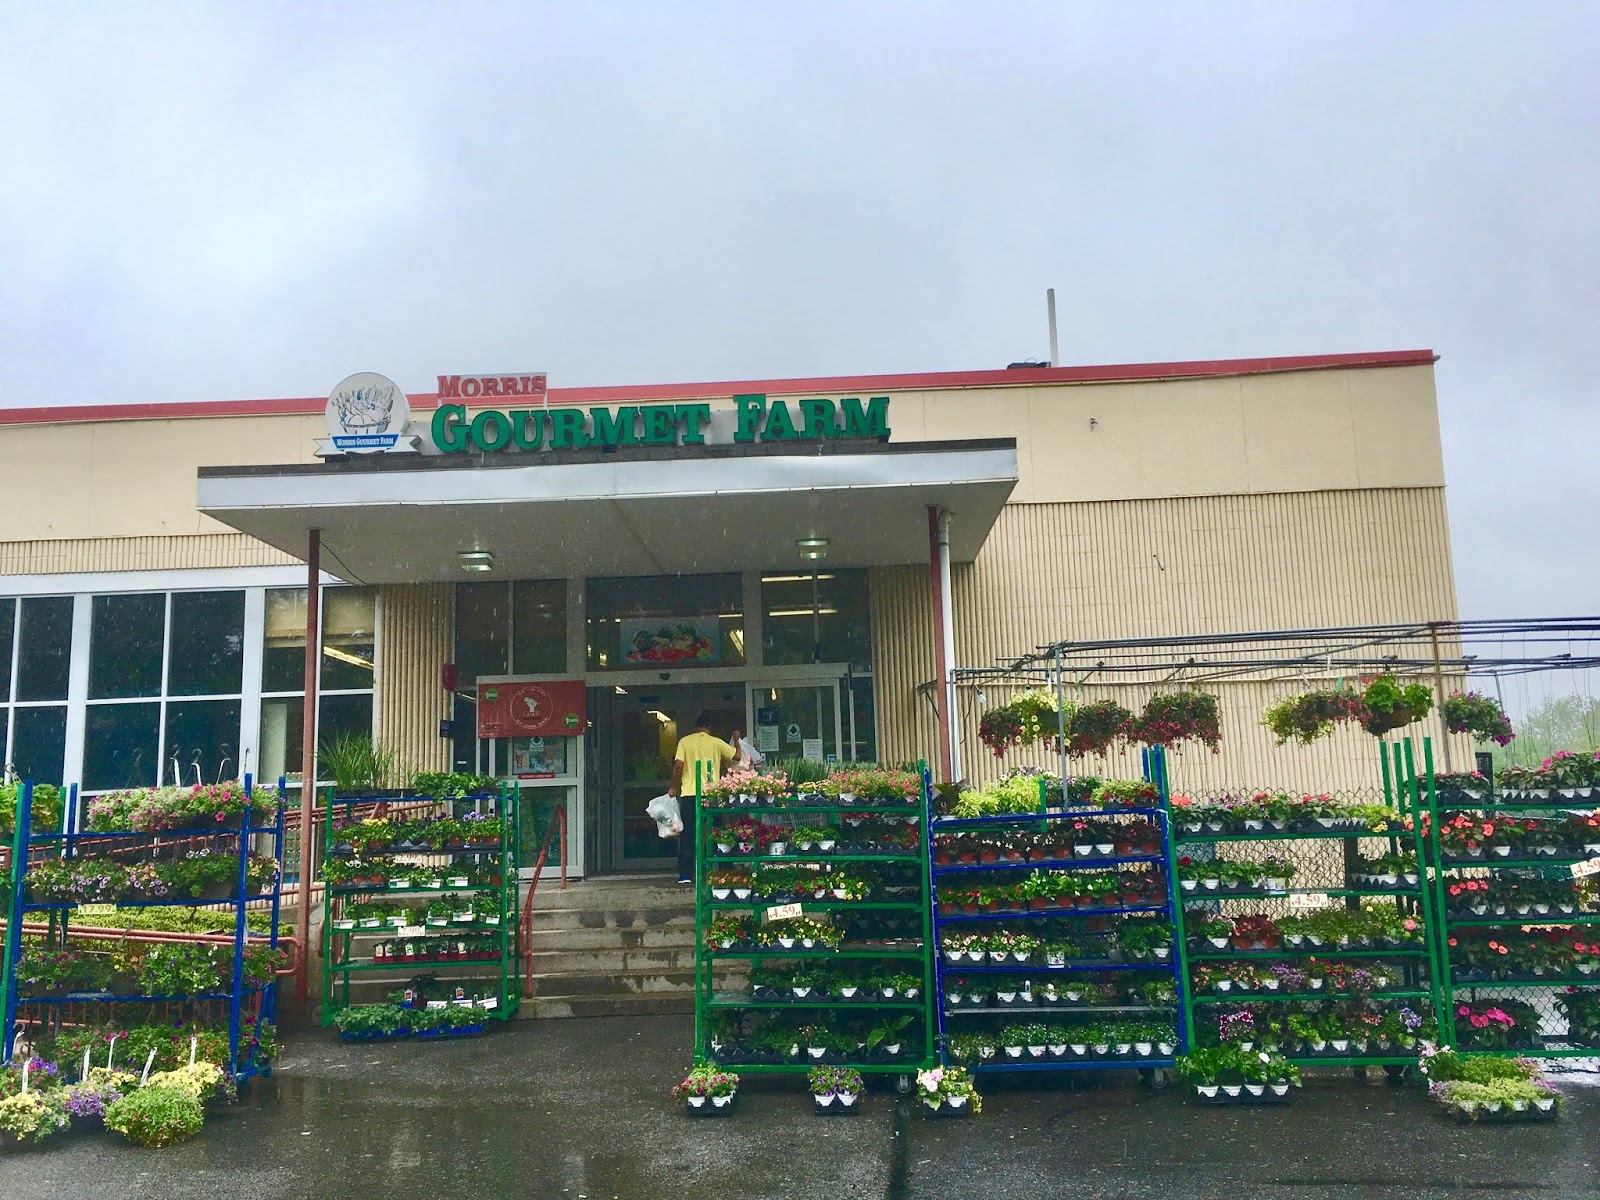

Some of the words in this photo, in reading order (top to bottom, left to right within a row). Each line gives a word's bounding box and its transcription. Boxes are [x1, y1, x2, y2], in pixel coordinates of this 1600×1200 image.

[437, 375, 546, 398] MORRIS
[431, 403, 711, 452] GOURMET
[733, 394, 891, 442] FARM
